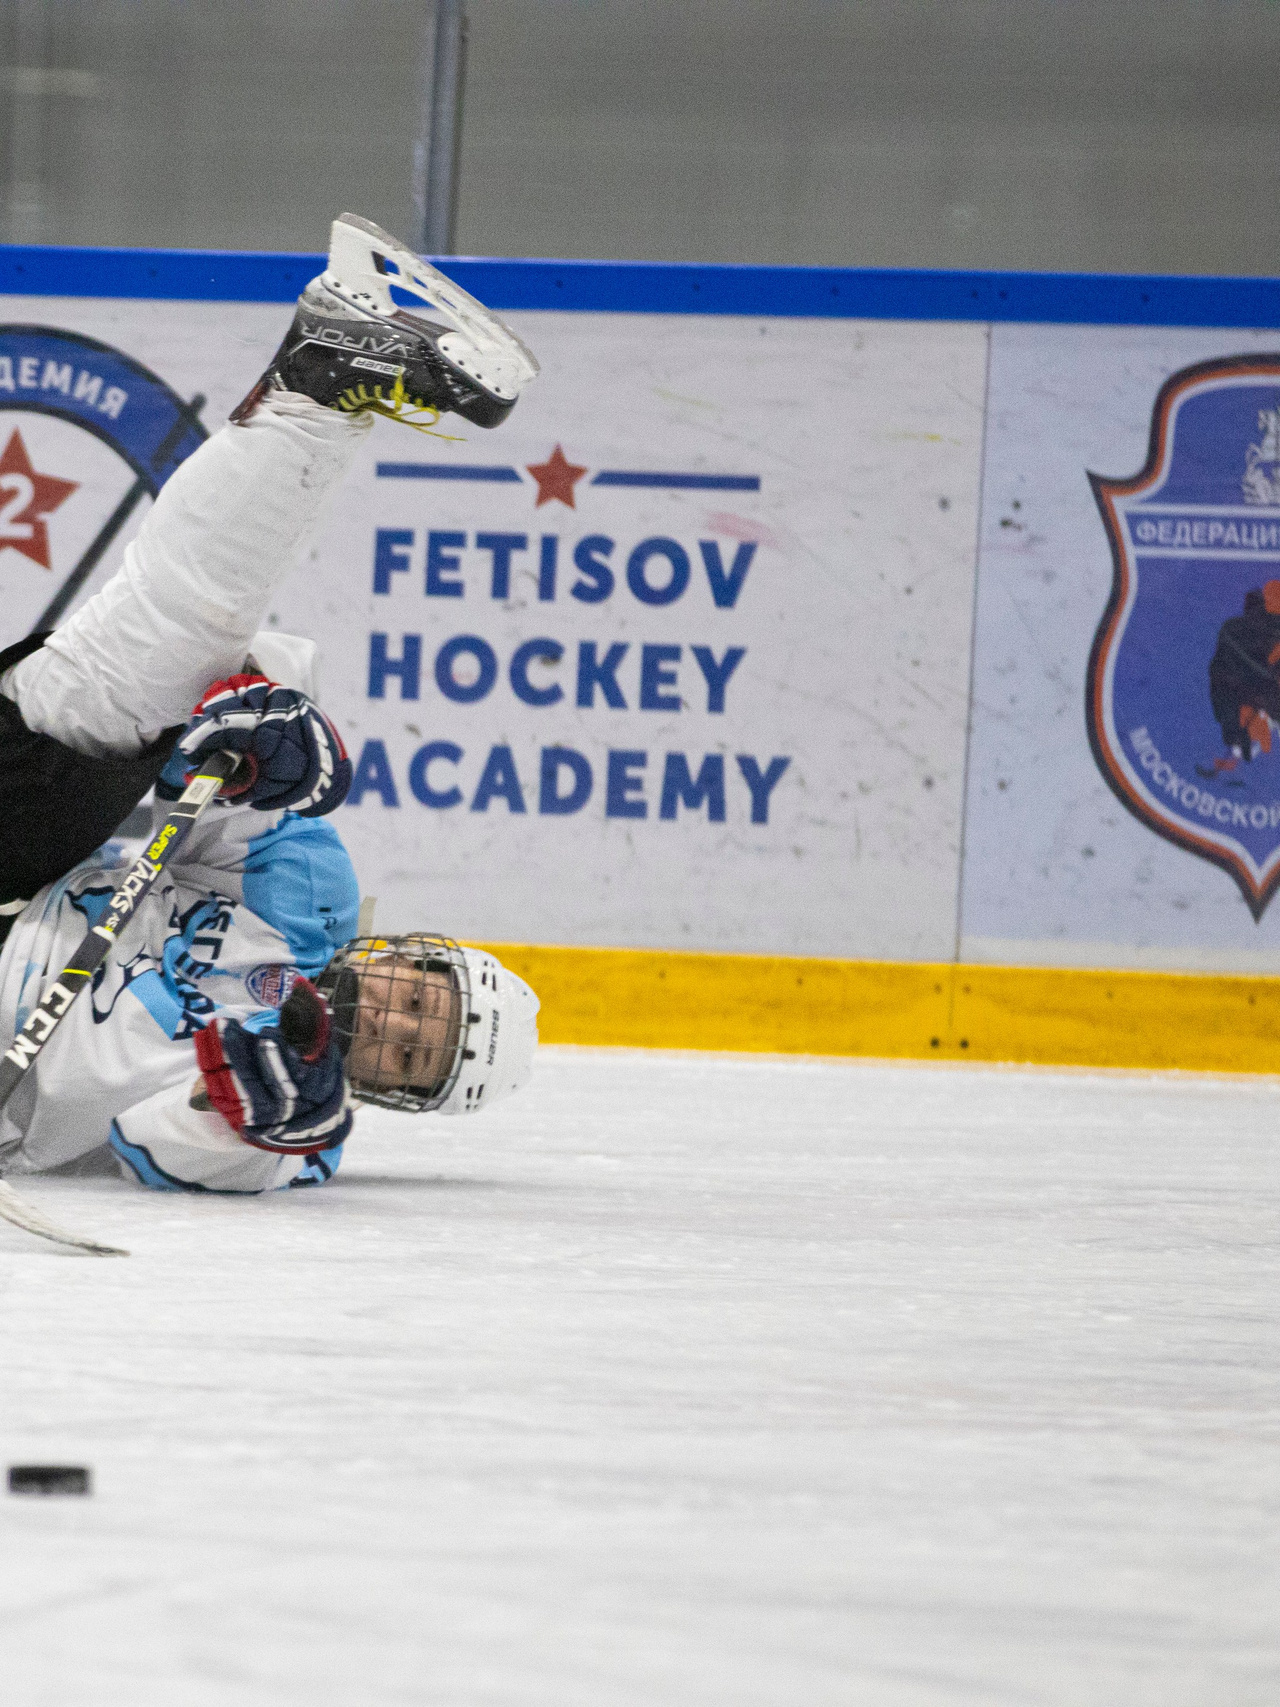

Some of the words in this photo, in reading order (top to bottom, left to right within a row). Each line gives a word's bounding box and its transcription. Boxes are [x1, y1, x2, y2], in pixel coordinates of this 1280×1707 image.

[372, 526, 760, 611] FETISOV
[366, 631, 748, 714] HOCKEY
[344, 737, 793, 825] ACADEMY
[146, 824, 178, 860] SUPER
[110, 857, 163, 913] TACKS
[5, 982, 77, 1071] CCM
[485, 1009, 500, 1067] BAUER
